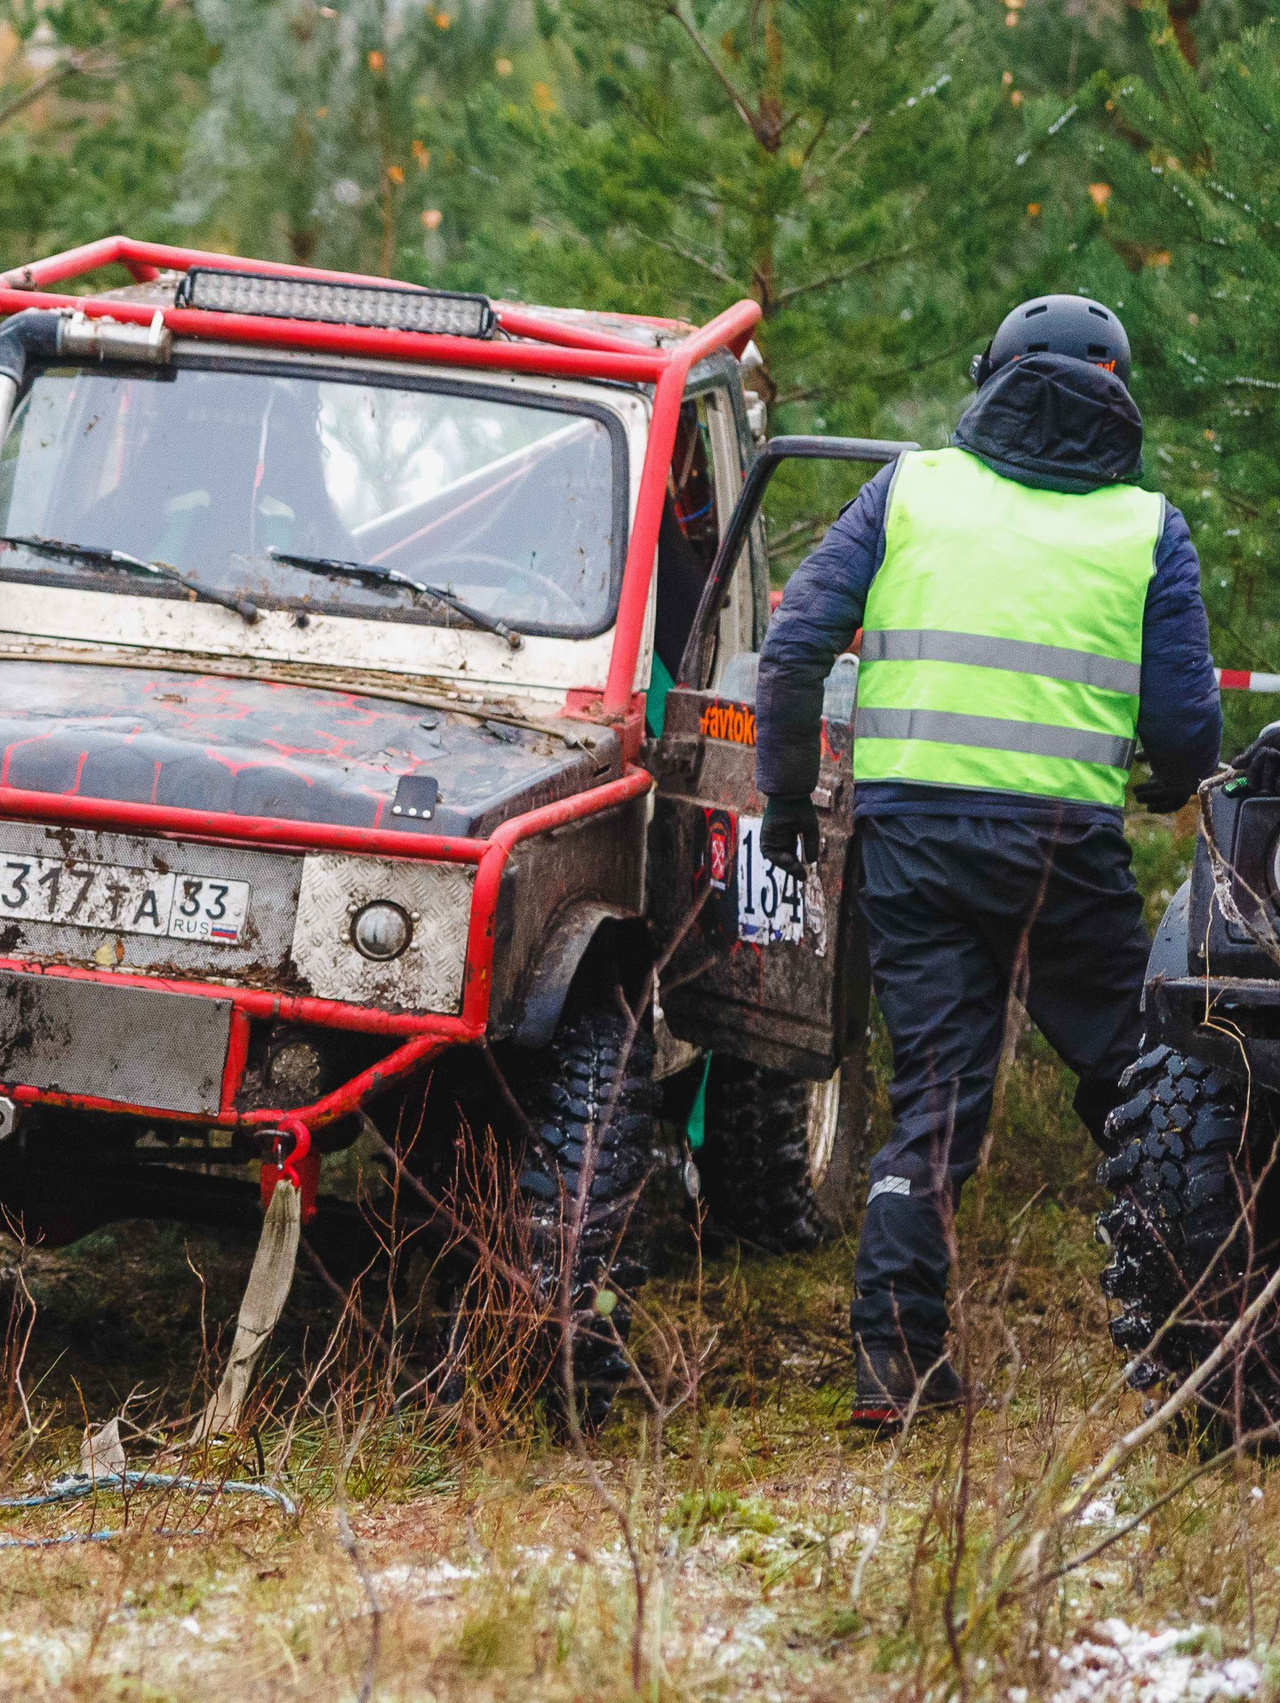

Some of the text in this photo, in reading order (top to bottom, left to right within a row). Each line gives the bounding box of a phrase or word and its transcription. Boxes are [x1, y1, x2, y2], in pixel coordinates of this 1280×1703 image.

[743, 830, 802, 923] 134
[180, 880, 229, 920] 33
[173, 918, 210, 935] RUS
